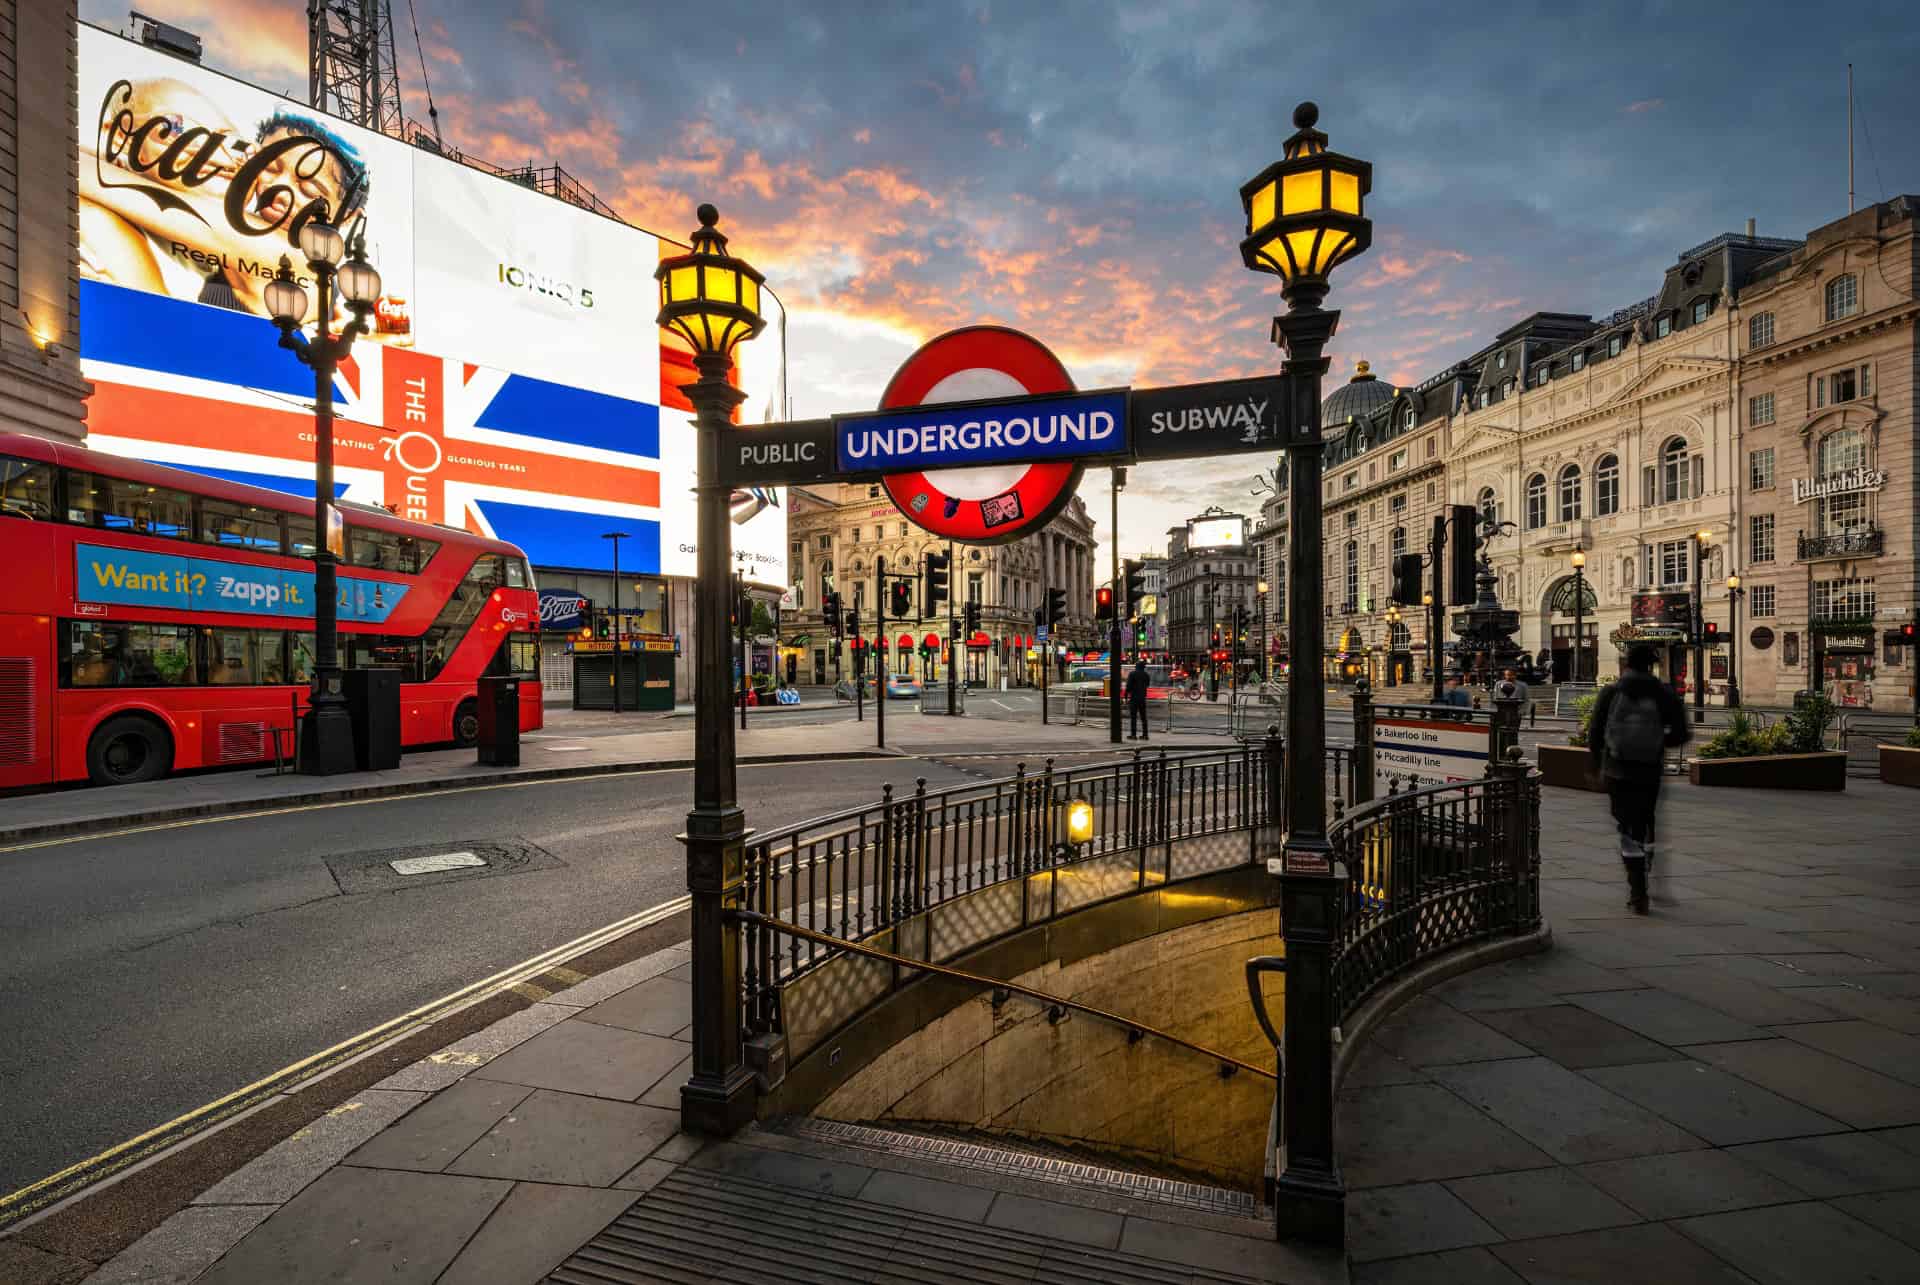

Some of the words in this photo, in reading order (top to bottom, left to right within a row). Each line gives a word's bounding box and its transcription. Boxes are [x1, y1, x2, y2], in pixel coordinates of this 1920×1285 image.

[171, 241, 230, 269] Real
[238, 258, 309, 288] Maic
[580, 288, 594, 308] 5
[405, 377, 426, 423] THE
[741, 441, 816, 466] PUBLIC
[847, 411, 1115, 458] UNDERGROUND
[1151, 400, 1268, 434] SUBWAY
[679, 543, 698, 554] Gal
[91, 561, 169, 593] Want
[175, 570, 207, 596] it?
[219, 576, 280, 608] Zapp
[284, 583, 304, 604] it.
[540, 595, 583, 621] Boot
[1384, 728, 1419, 740] Bakerloo
[1422, 730, 1439, 742] line
[1384, 752, 1422, 768] Piccadilly
[1424, 757, 1441, 767] line
